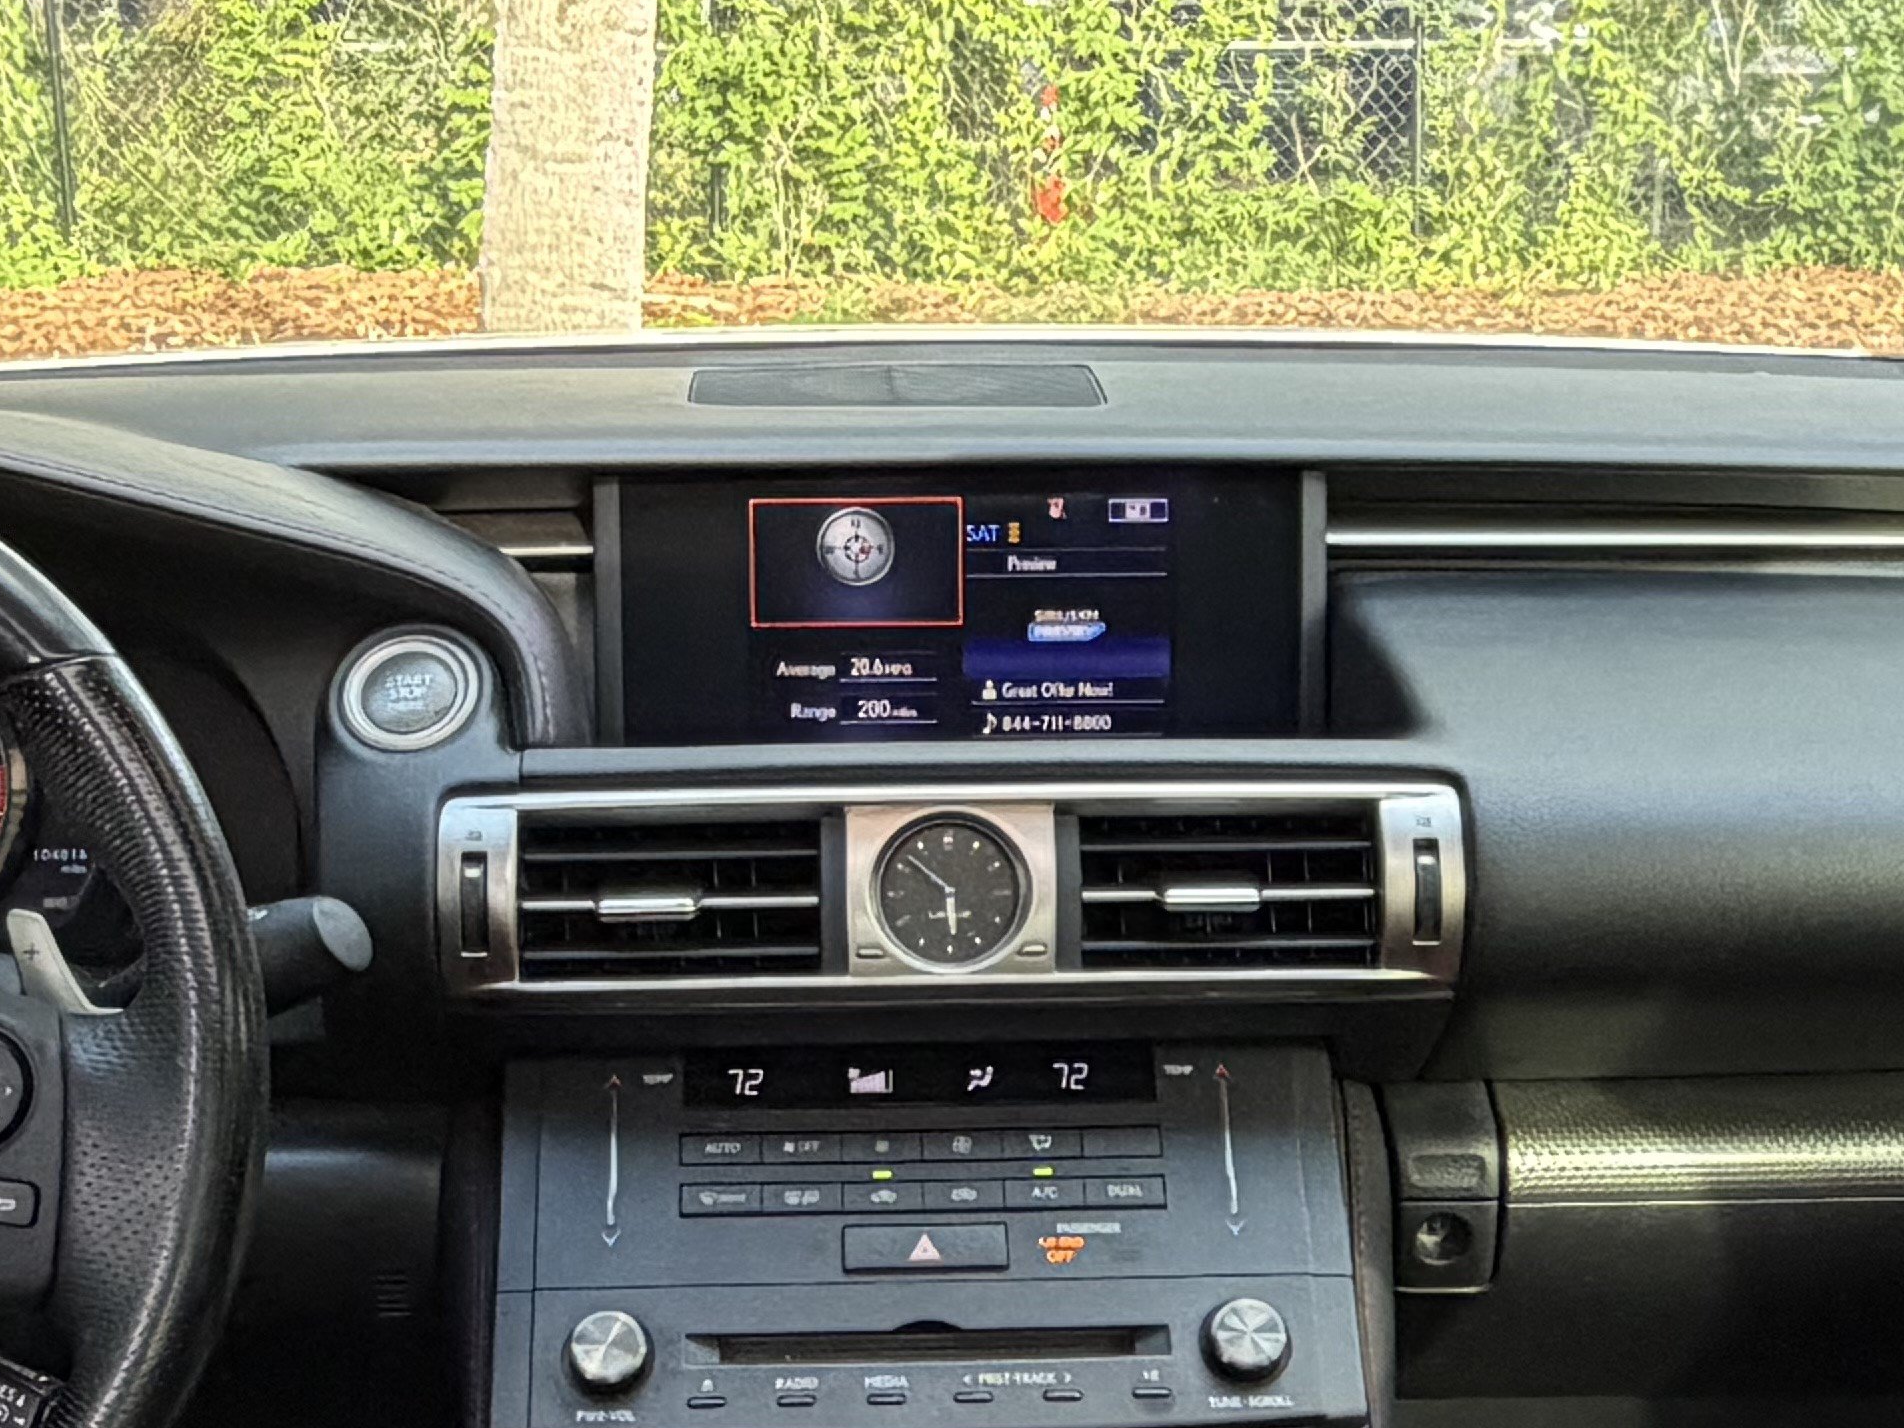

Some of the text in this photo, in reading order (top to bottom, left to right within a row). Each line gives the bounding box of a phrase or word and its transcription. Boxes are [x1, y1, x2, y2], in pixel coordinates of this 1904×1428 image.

[966, 523, 1001, 543] SAT
[1006, 554, 1058, 572] Preview
[776, 660, 837, 680] Average
[1002, 681, 1038, 699] Great
[789, 702, 837, 722] Range
[857, 699, 891, 718] 200
[726, 1067, 765, 1097] 72
[1051, 1062, 1090, 1091] 72
[1030, 1186, 1060, 1200] A/C
